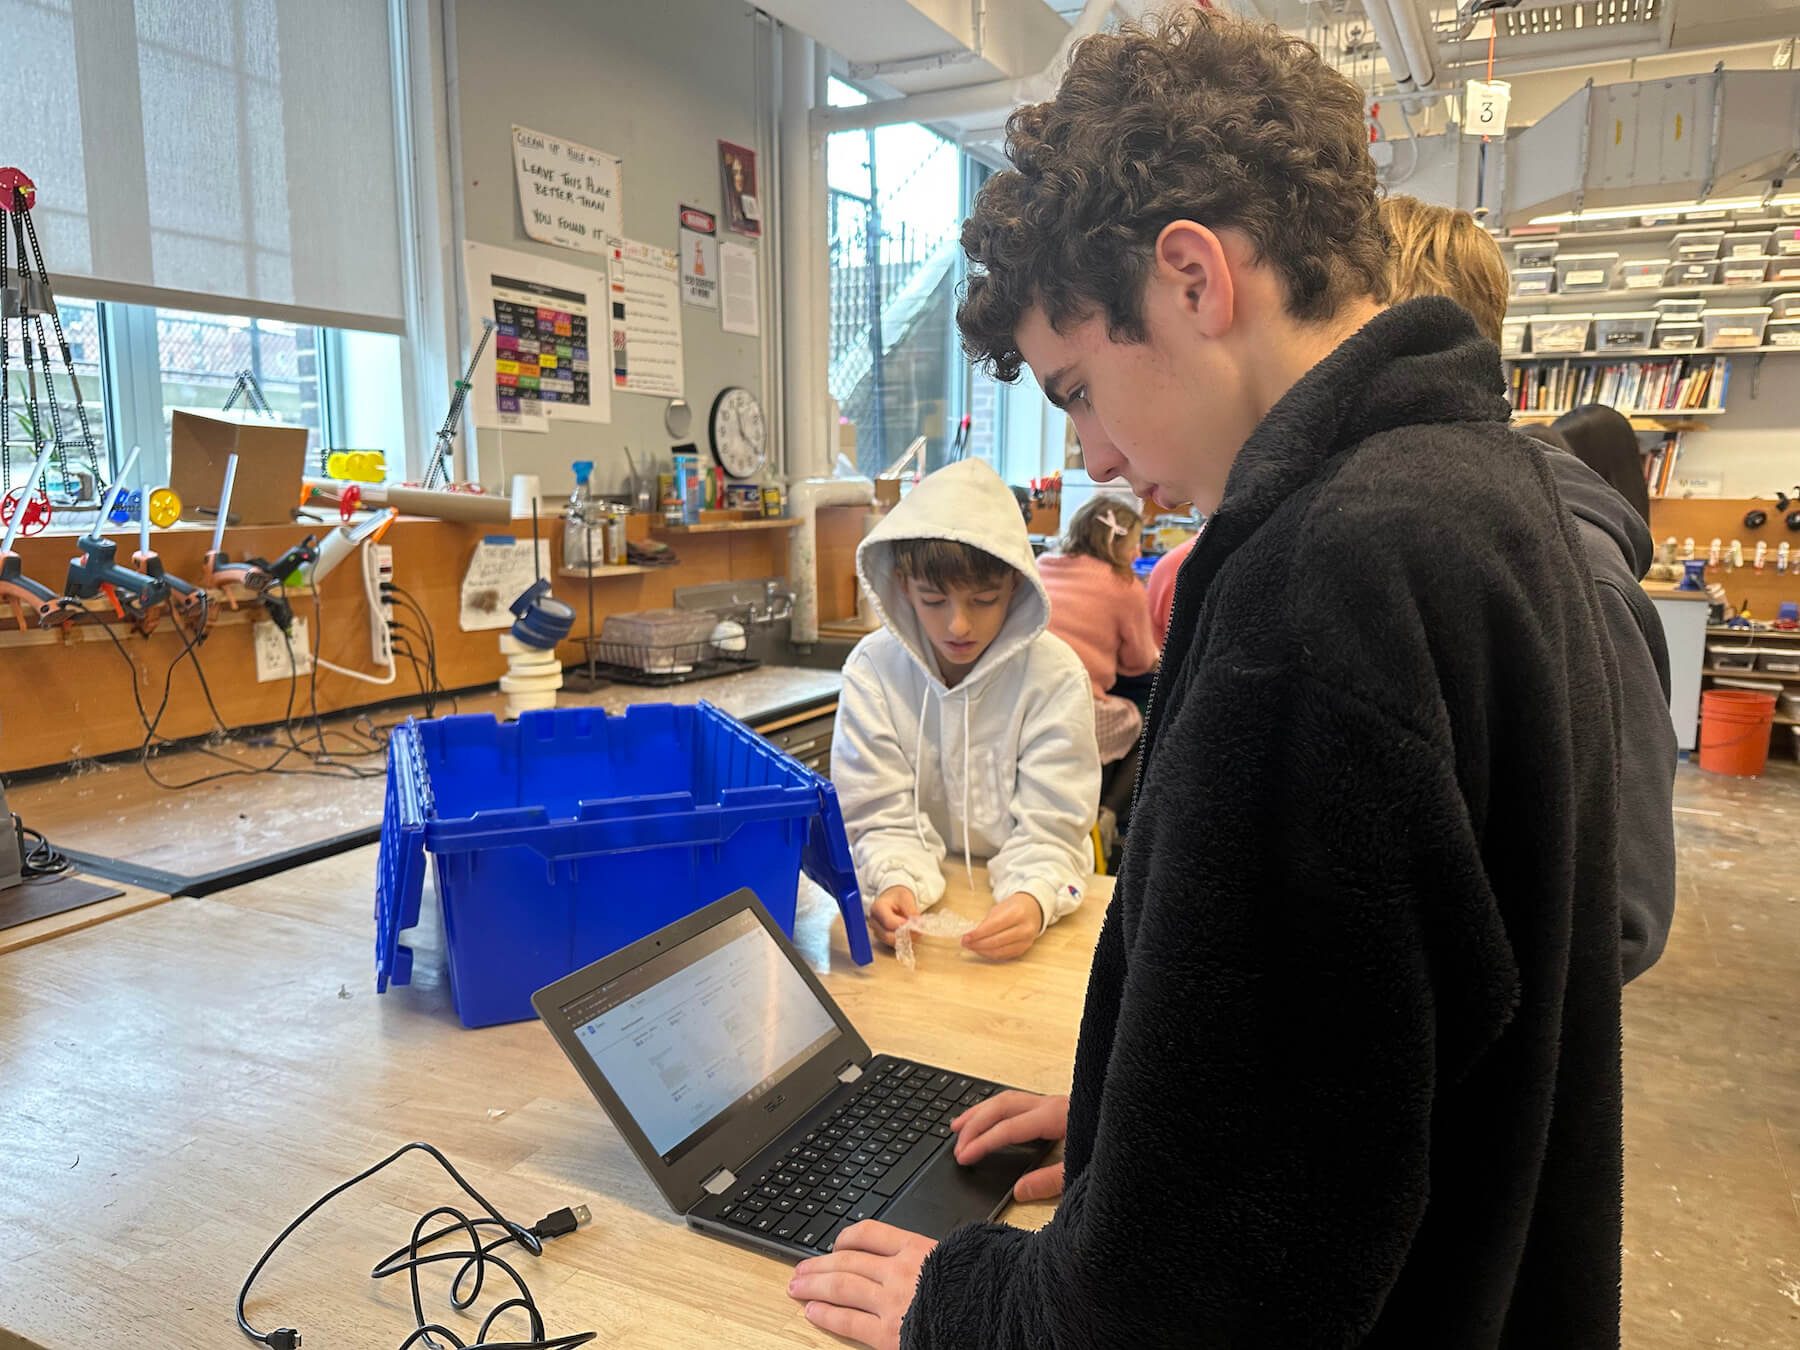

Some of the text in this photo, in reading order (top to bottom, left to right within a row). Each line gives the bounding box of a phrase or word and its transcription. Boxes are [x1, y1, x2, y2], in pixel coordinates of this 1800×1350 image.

[1480, 102, 1493, 122] 3
[522, 157, 611, 198] LEAVE THIS PLACE
[533, 182, 605, 213] BETTER THAN
[533, 208, 604, 240] YOU FOUND IT
